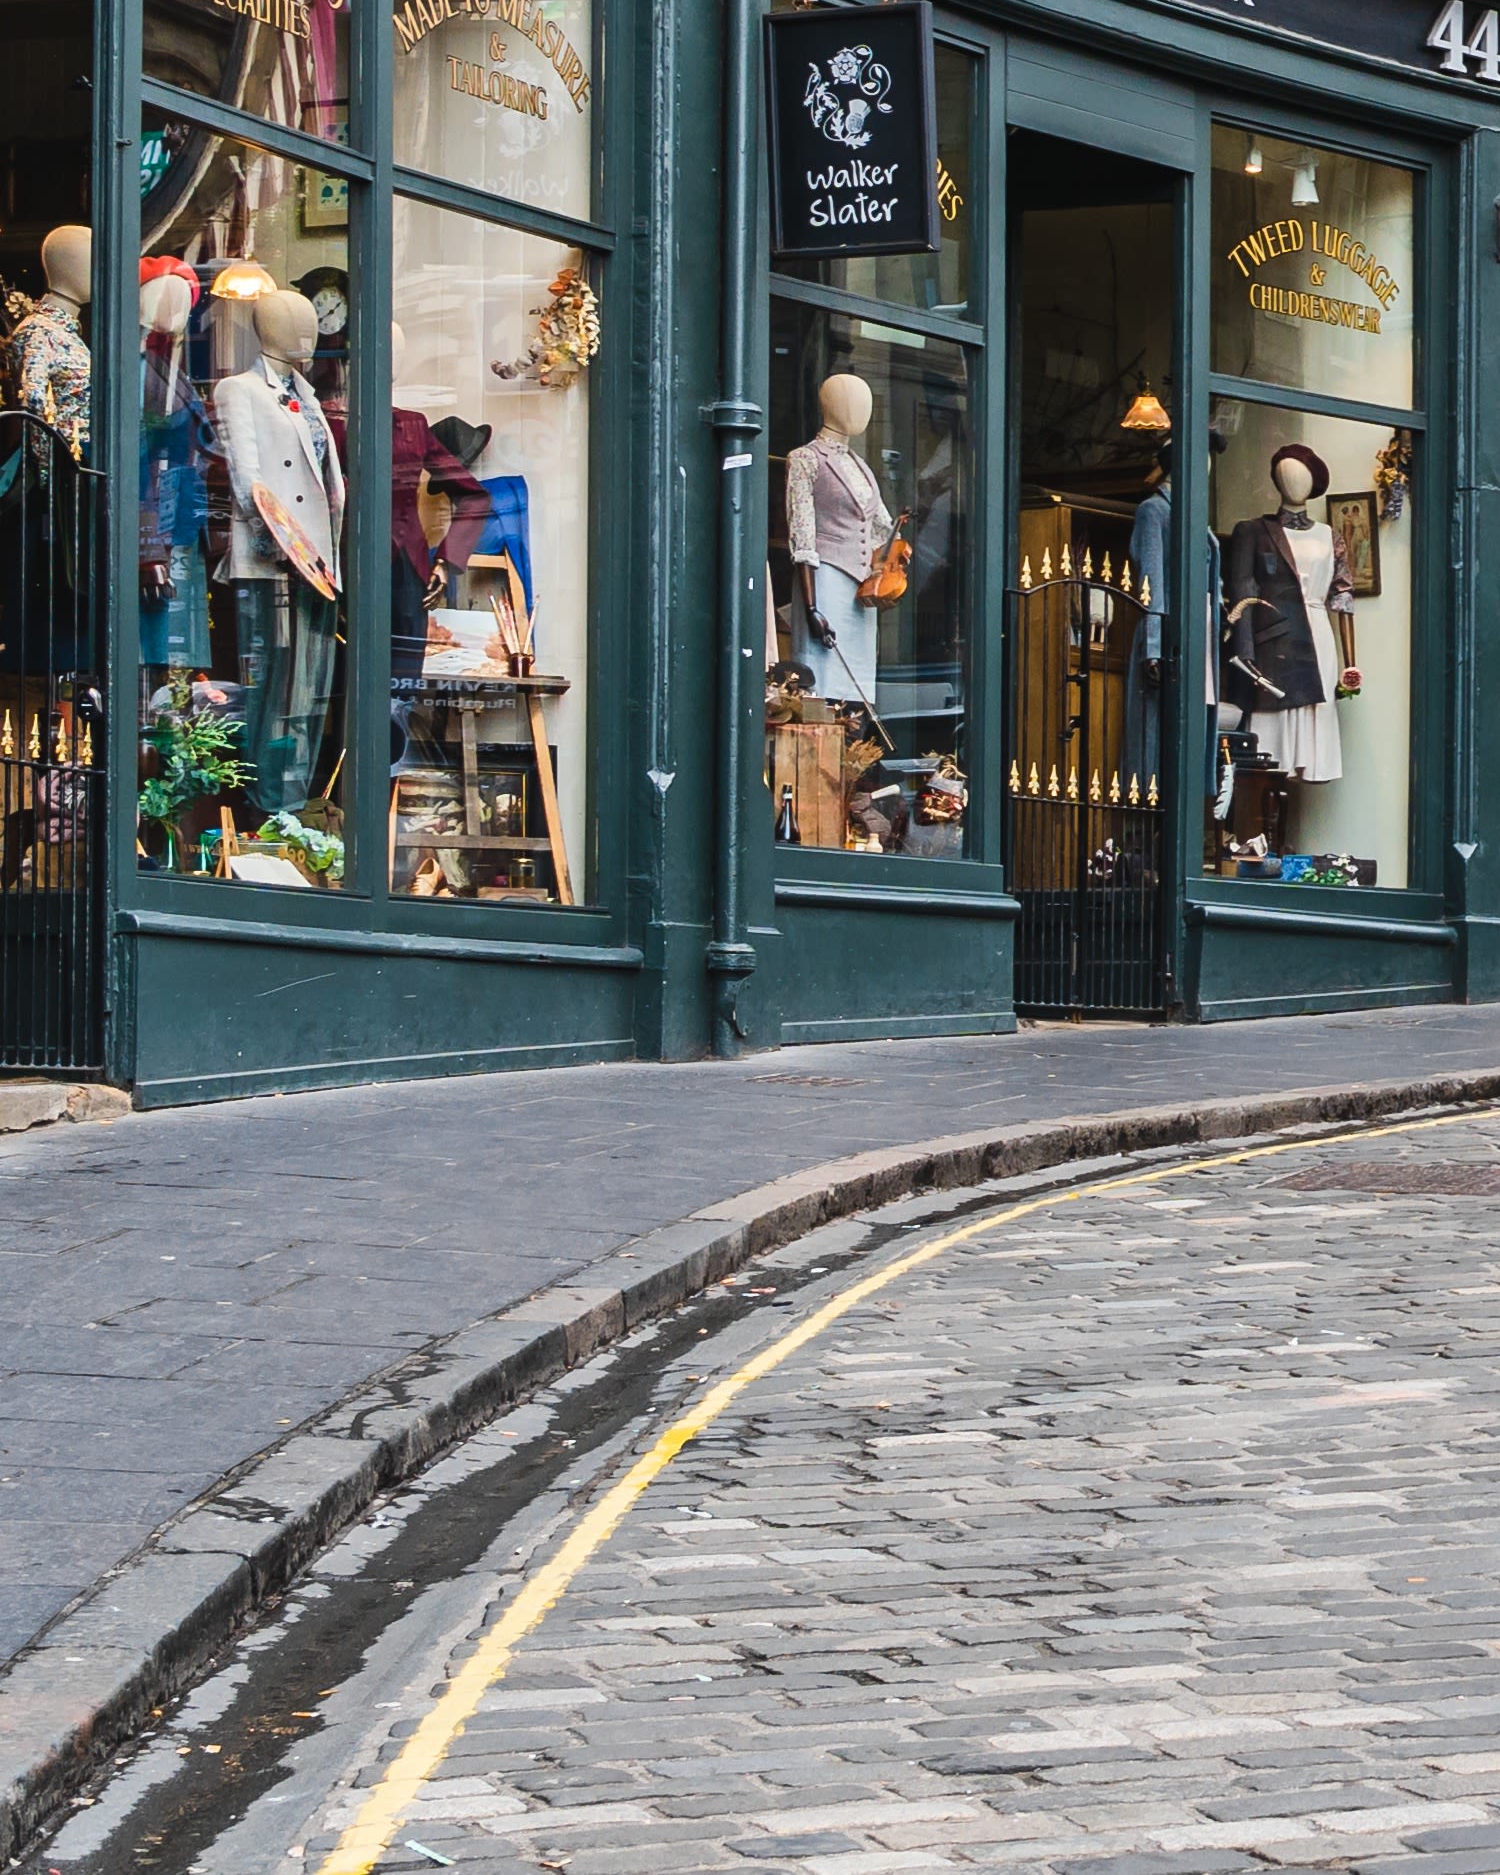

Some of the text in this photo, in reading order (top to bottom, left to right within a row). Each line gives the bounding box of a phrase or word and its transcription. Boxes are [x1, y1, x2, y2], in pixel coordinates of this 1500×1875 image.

[489, 31, 507, 63] &
[447, 55, 548, 121] TAILORING
[809, 192, 899, 227] Slater
[1227, 219, 1400, 312] TWEED LUGGAGE
[1310, 262, 1326, 286] &
[1249, 283, 1381, 335] CHILDRENSWEAR
